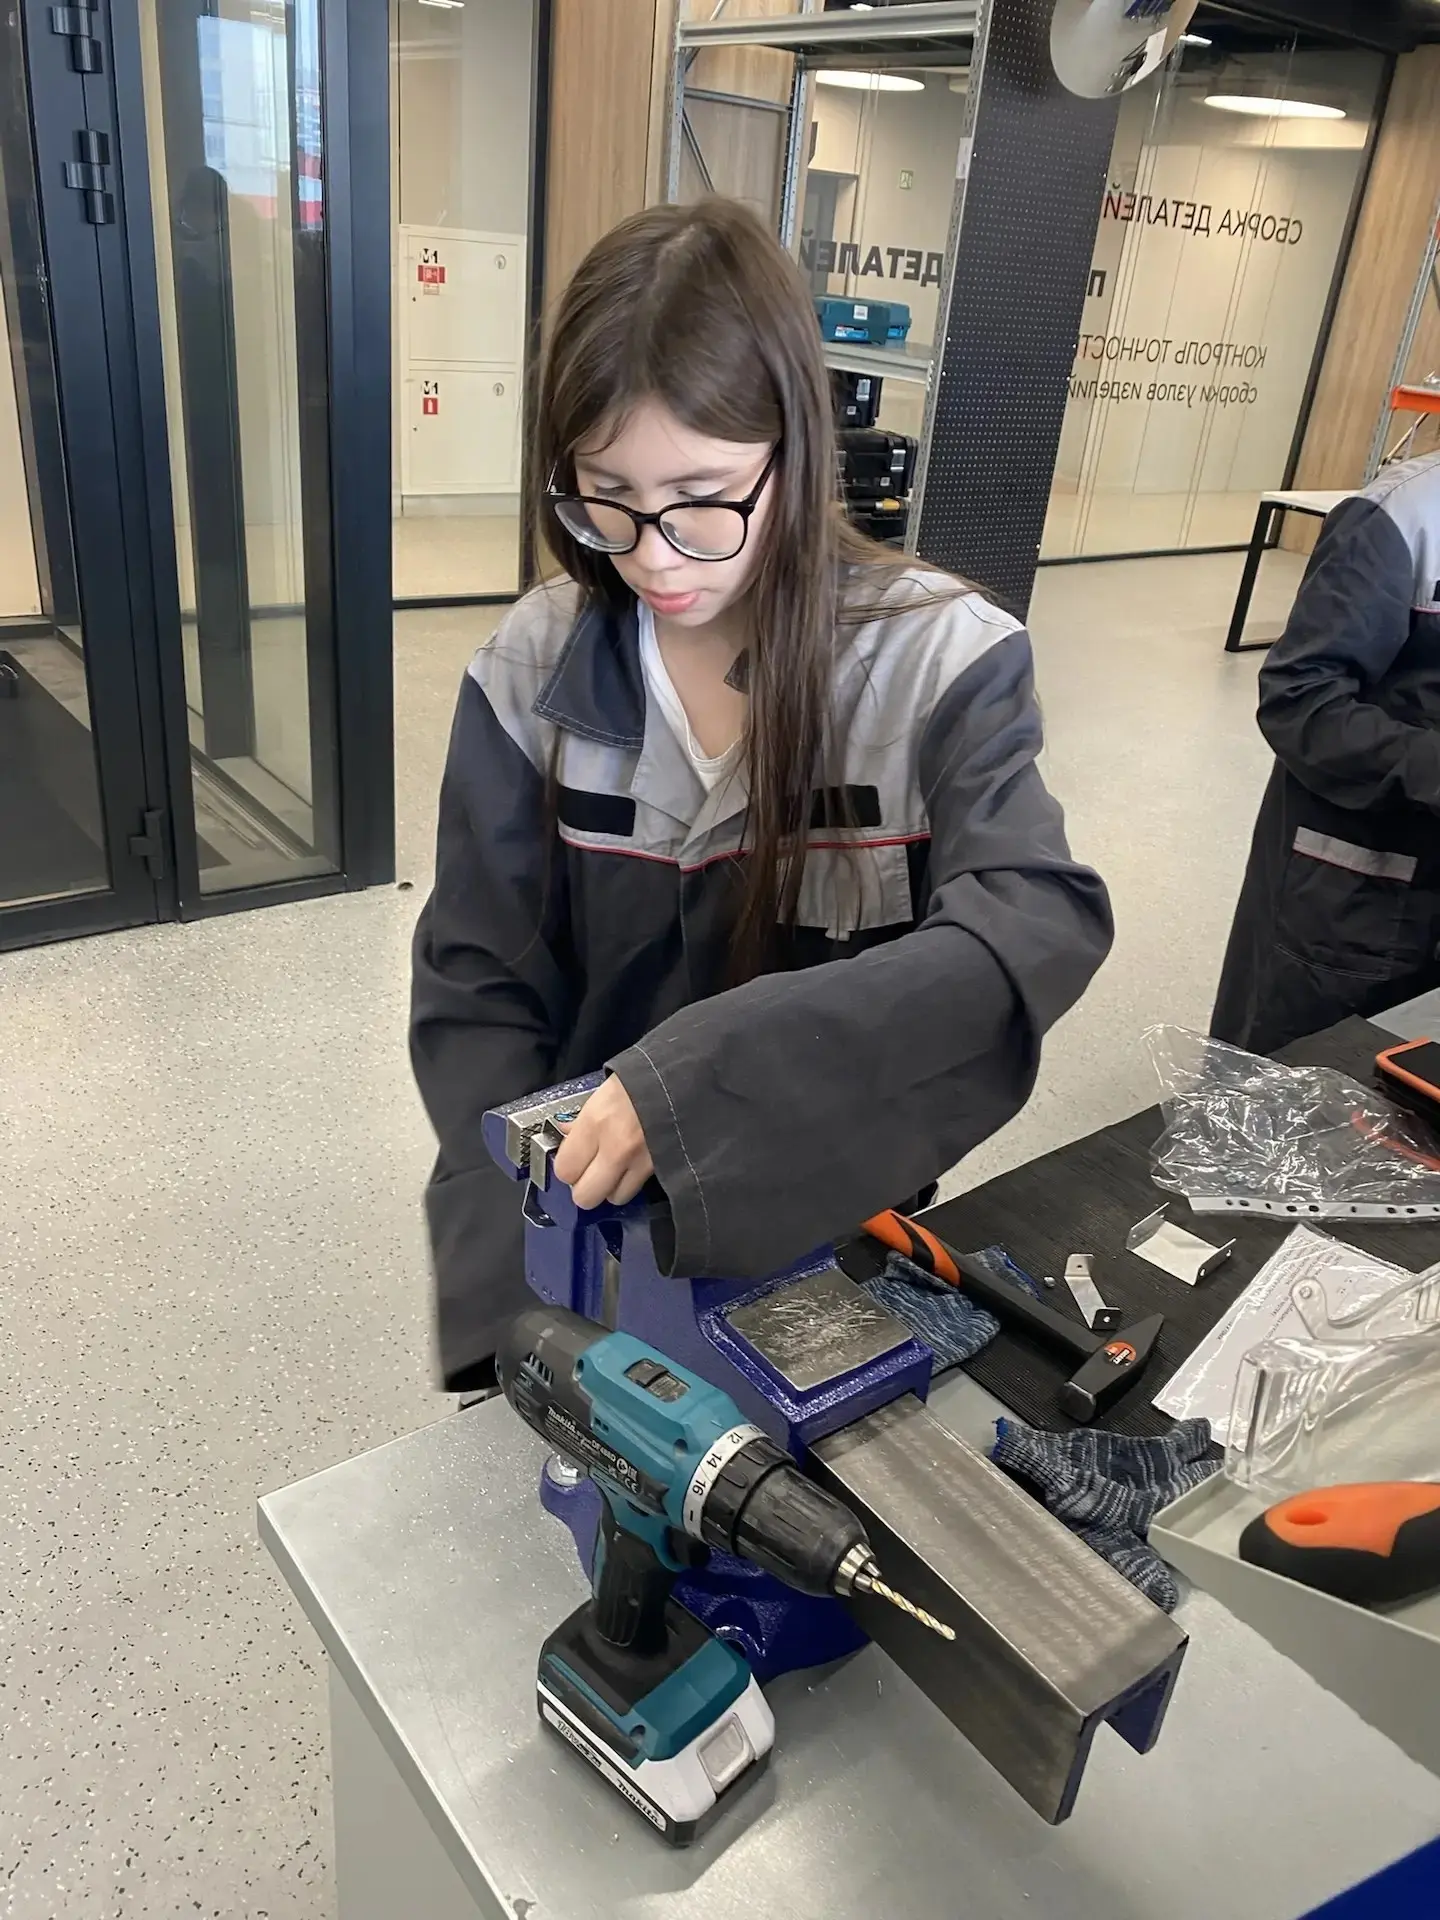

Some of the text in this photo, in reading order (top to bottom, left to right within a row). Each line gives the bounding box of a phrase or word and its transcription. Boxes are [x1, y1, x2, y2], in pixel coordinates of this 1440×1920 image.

[727, 1432, 744, 1445] 12
[706, 1453, 722, 1469] 14
[692, 1479, 706, 1496] 16
